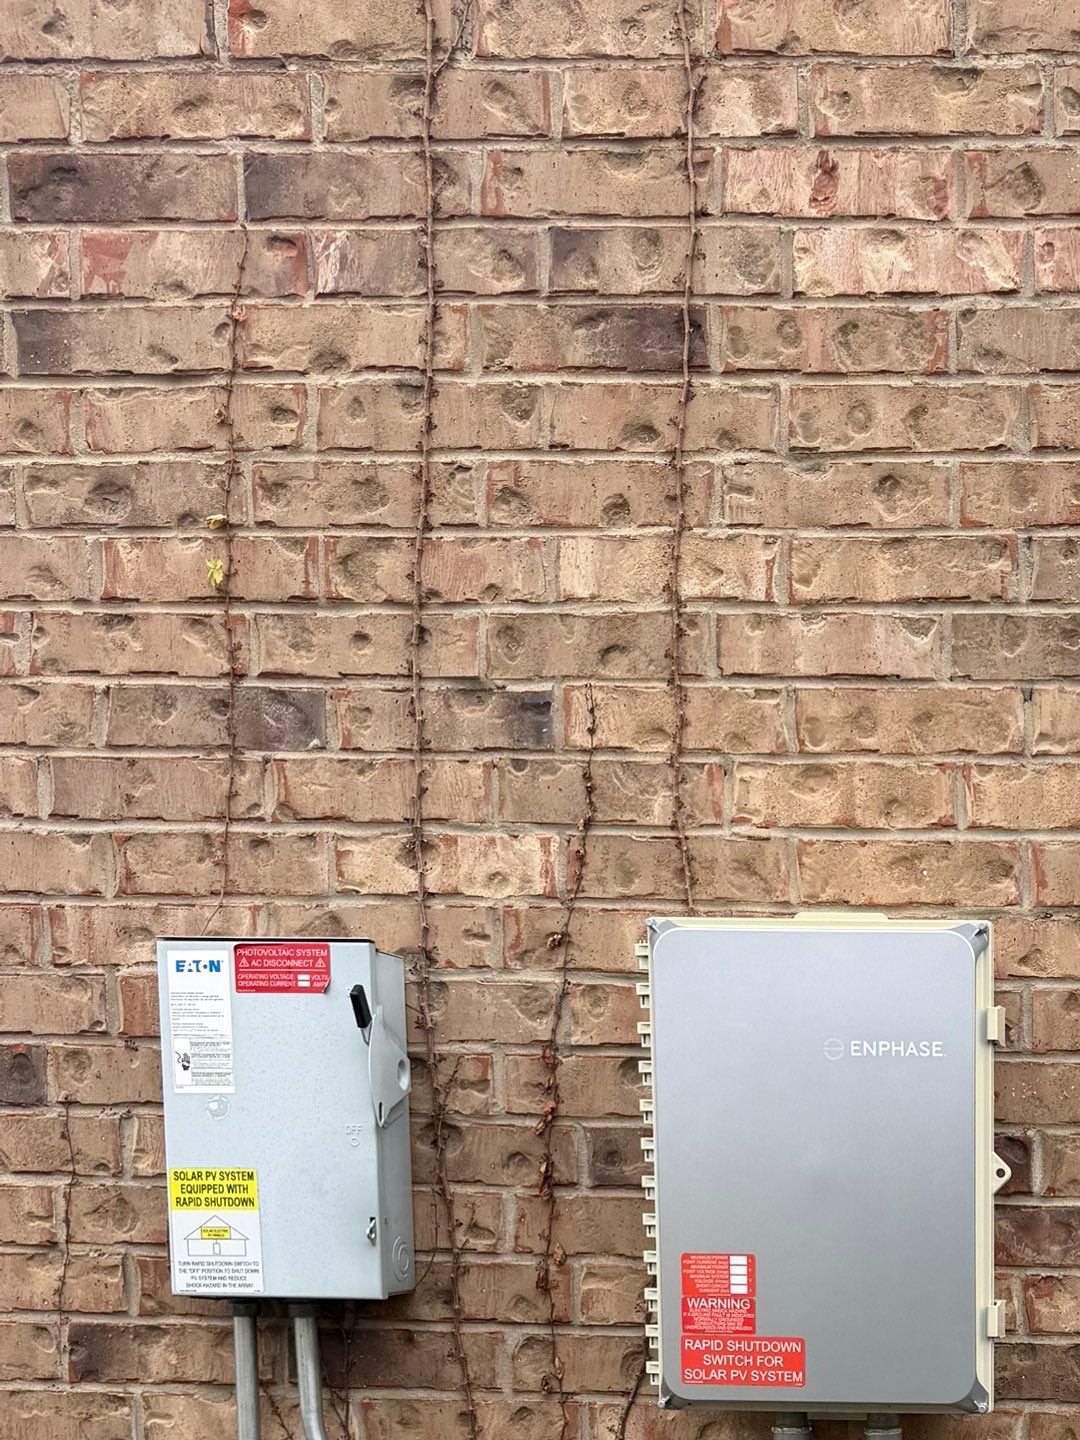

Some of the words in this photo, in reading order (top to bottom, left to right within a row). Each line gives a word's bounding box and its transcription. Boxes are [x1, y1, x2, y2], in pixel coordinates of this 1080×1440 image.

[236, 948, 295, 957] PHOTOVOLTAIC
[296, 948, 328, 957] SYSTEM
[175, 959, 221, 973] EATON
[251, 959, 262, 967] AC
[263, 959, 313, 967] DISCONNECT
[173, 1170, 203, 1181] SOLAR
[205, 1170, 217, 1181] PV
[219, 1170, 255, 1181] SYSTEM
[180, 1183, 225, 1194] EQUIPPED
[226, 1183, 249, 1194] WITH
[175, 1196, 202, 1207] RAPID
[204, 1196, 255, 1207] SHUTDOWN
[686, 1297, 751, 1310] WARNING
[684, 1339, 724, 1351] RAPID
[726, 1340, 801, 1353] SHUTDOWN
[703, 1354, 753, 1367] SWITCH
[756, 1356, 784, 1367] FOR
[684, 1368, 727, 1380] SOLAR
[730, 1370, 748, 1381] PV
[750, 1370, 803, 1382] SYSTEM
